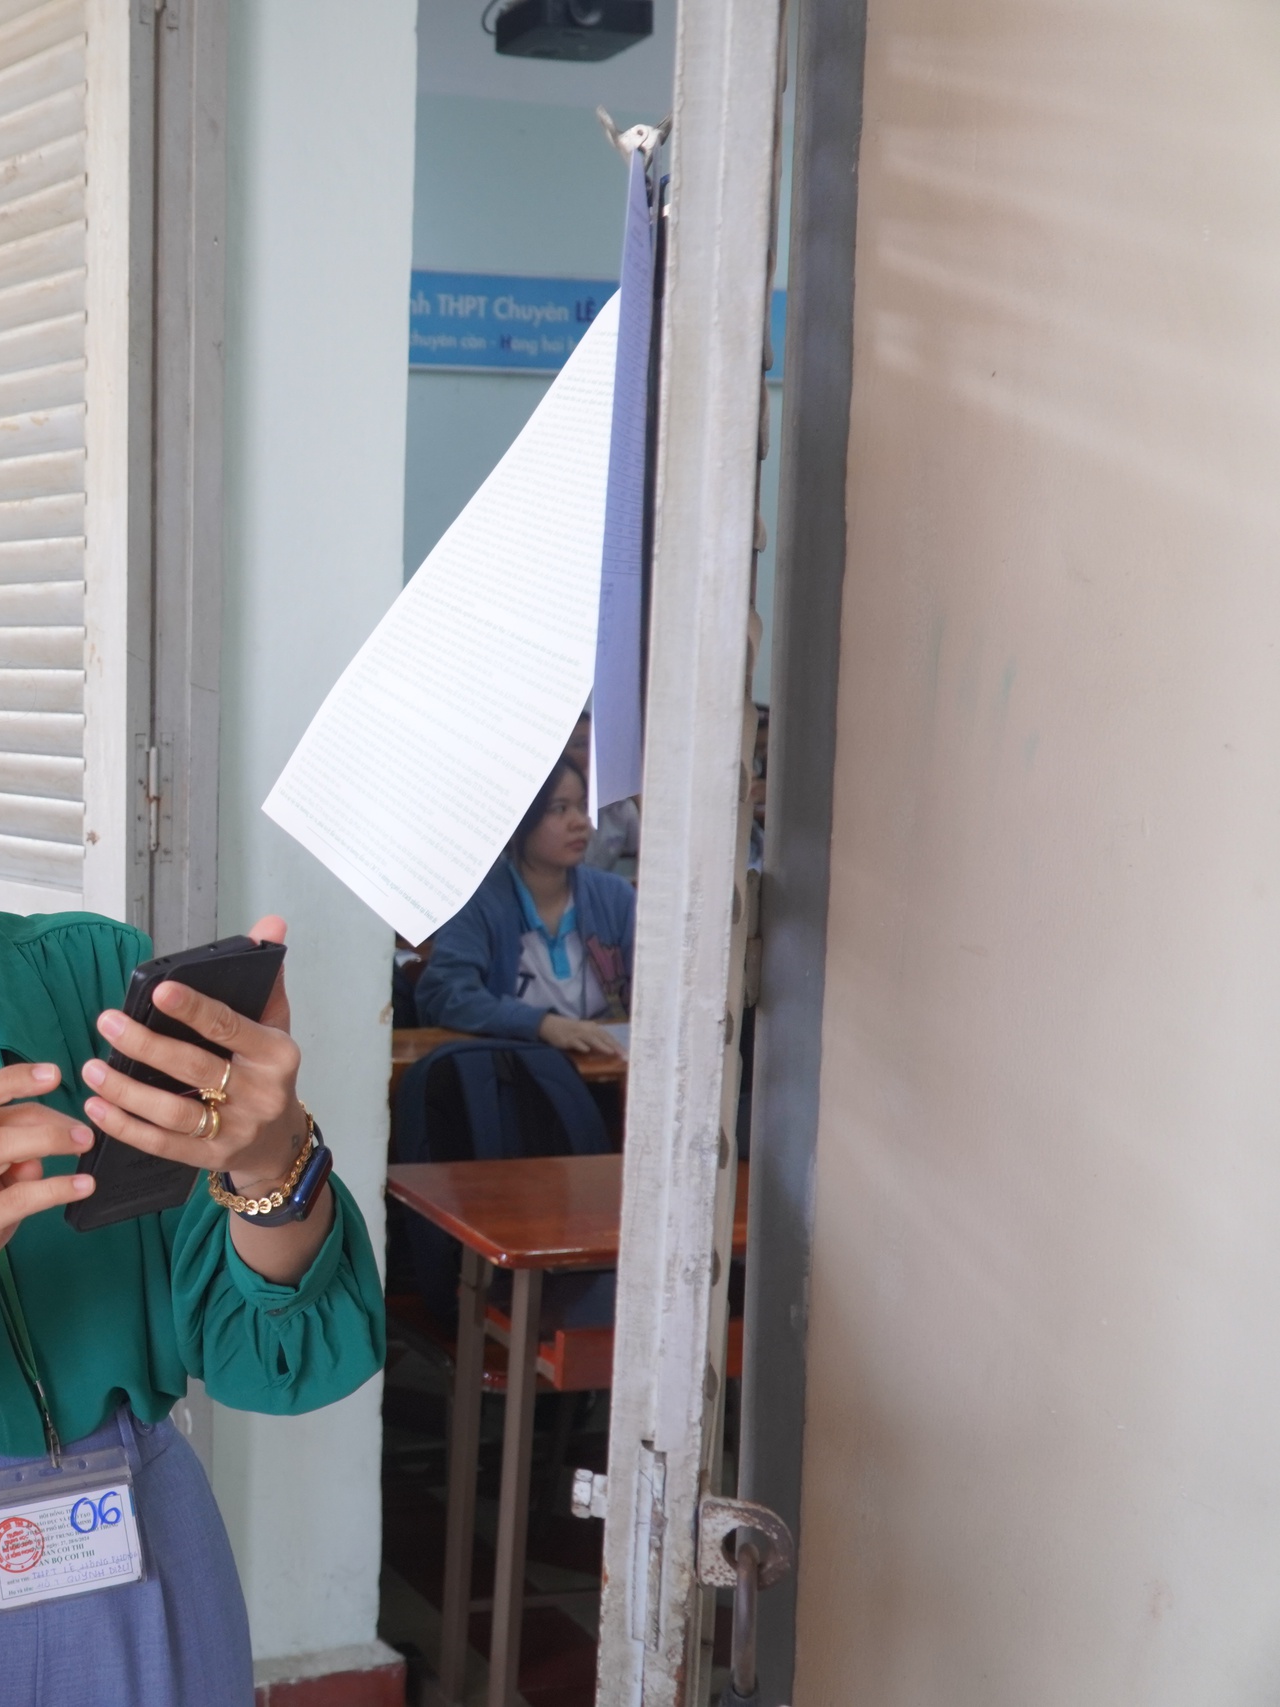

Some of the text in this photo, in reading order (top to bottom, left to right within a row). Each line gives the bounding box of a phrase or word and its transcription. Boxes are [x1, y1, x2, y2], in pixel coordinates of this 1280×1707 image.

[436, 293, 488, 318] THPT
[493, 293, 569, 328] Chuyên
[70, 1491, 122, 1533] 06
[64, 1552, 80, 1561] COI
[80, 1549, 95, 1558] THI
[72, 1543, 85, 1551] THI
